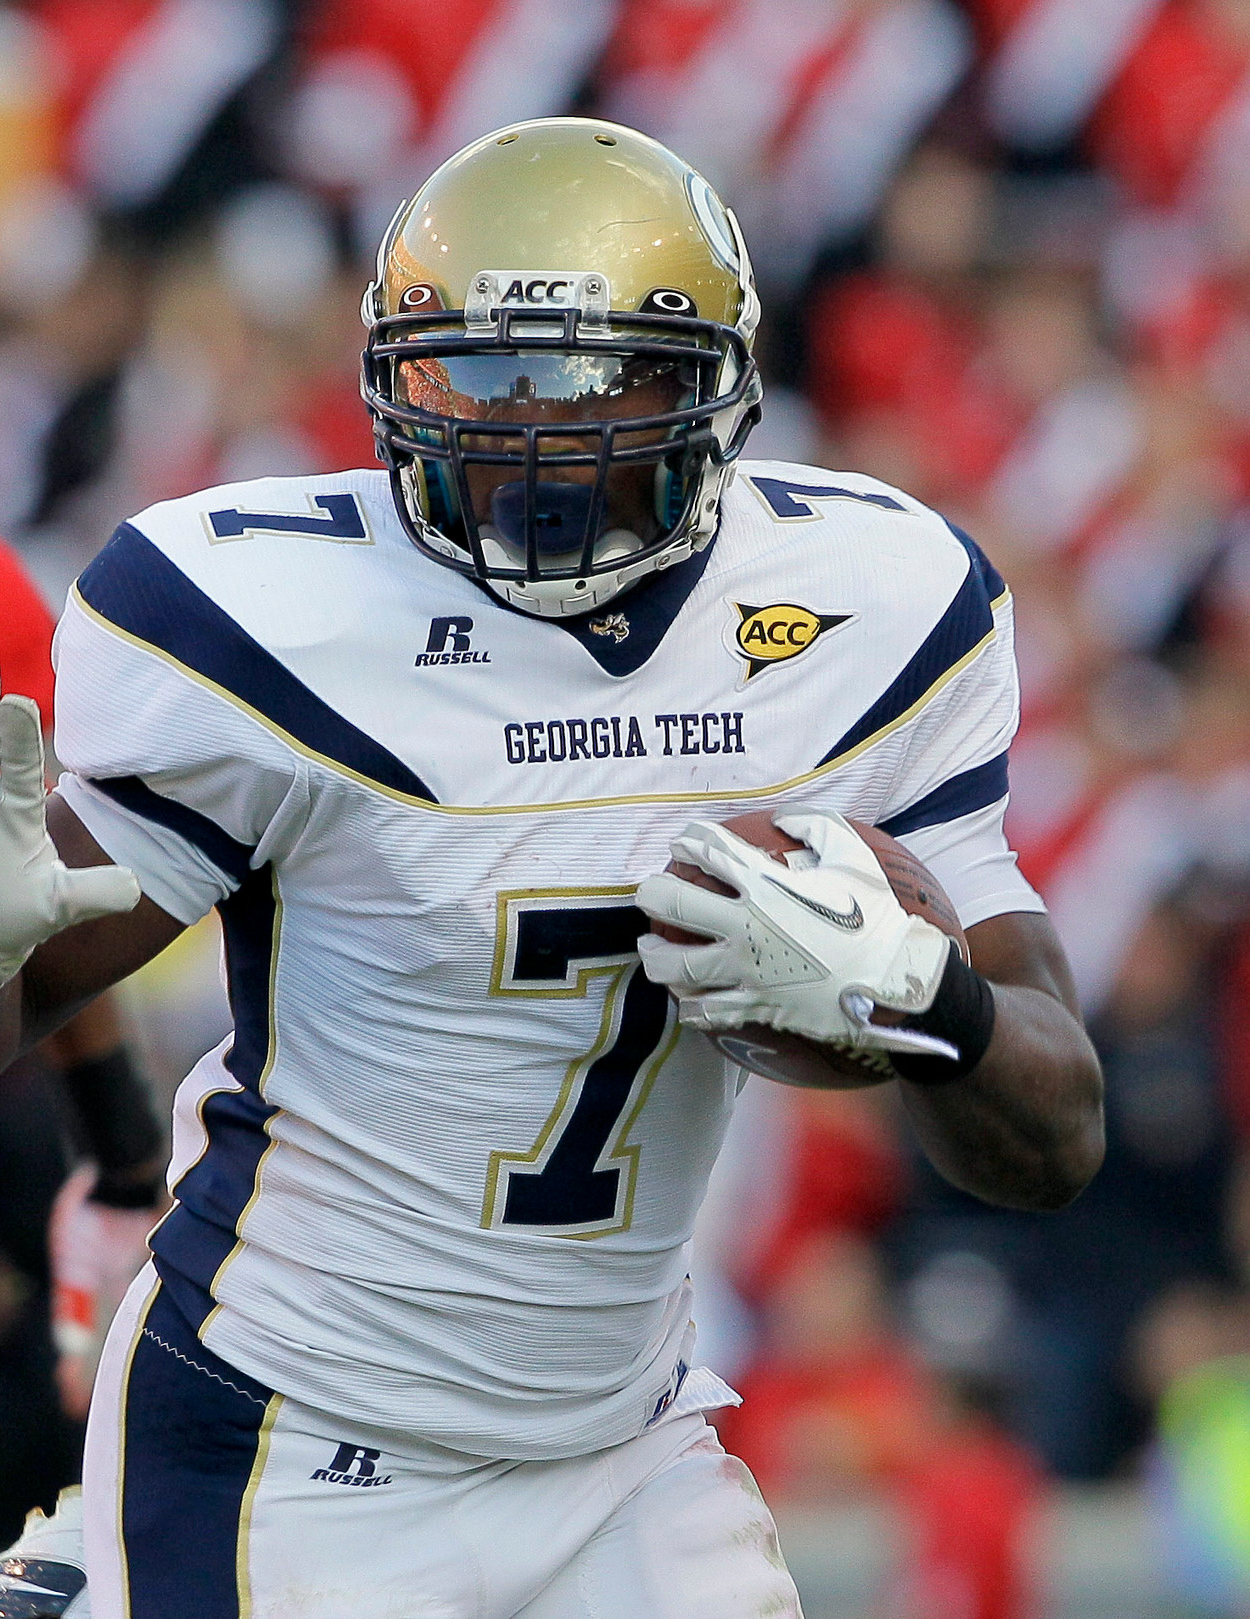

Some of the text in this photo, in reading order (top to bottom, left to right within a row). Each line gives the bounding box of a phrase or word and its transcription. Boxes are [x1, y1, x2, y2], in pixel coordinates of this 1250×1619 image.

[500, 279, 569, 304] ACC
[737, 473, 921, 524] 7
[199, 490, 376, 547] 7
[743, 619, 810, 646] ACC
[414, 650, 492, 668] RUSSELL
[503, 711, 747, 765] GEORGIA TECH
[480, 883, 684, 1241] 7
[309, 1468, 393, 1488] RUSSELL
